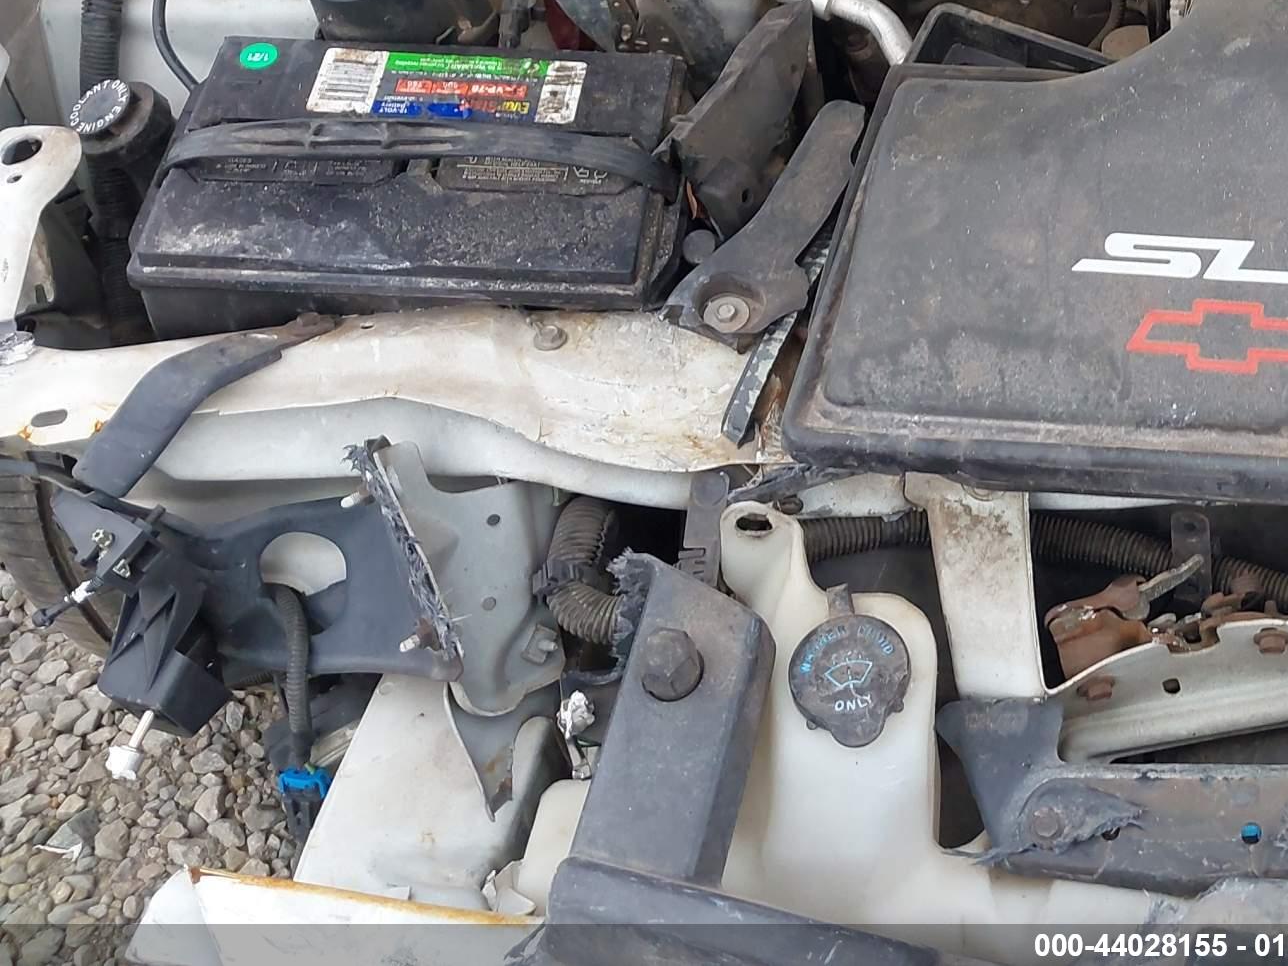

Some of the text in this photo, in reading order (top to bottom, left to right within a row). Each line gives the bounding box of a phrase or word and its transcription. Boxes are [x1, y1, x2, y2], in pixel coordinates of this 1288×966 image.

[69, 79, 129, 133] ENGINE COOLANT ONLY
[834, 694, 872, 712] ONLY
